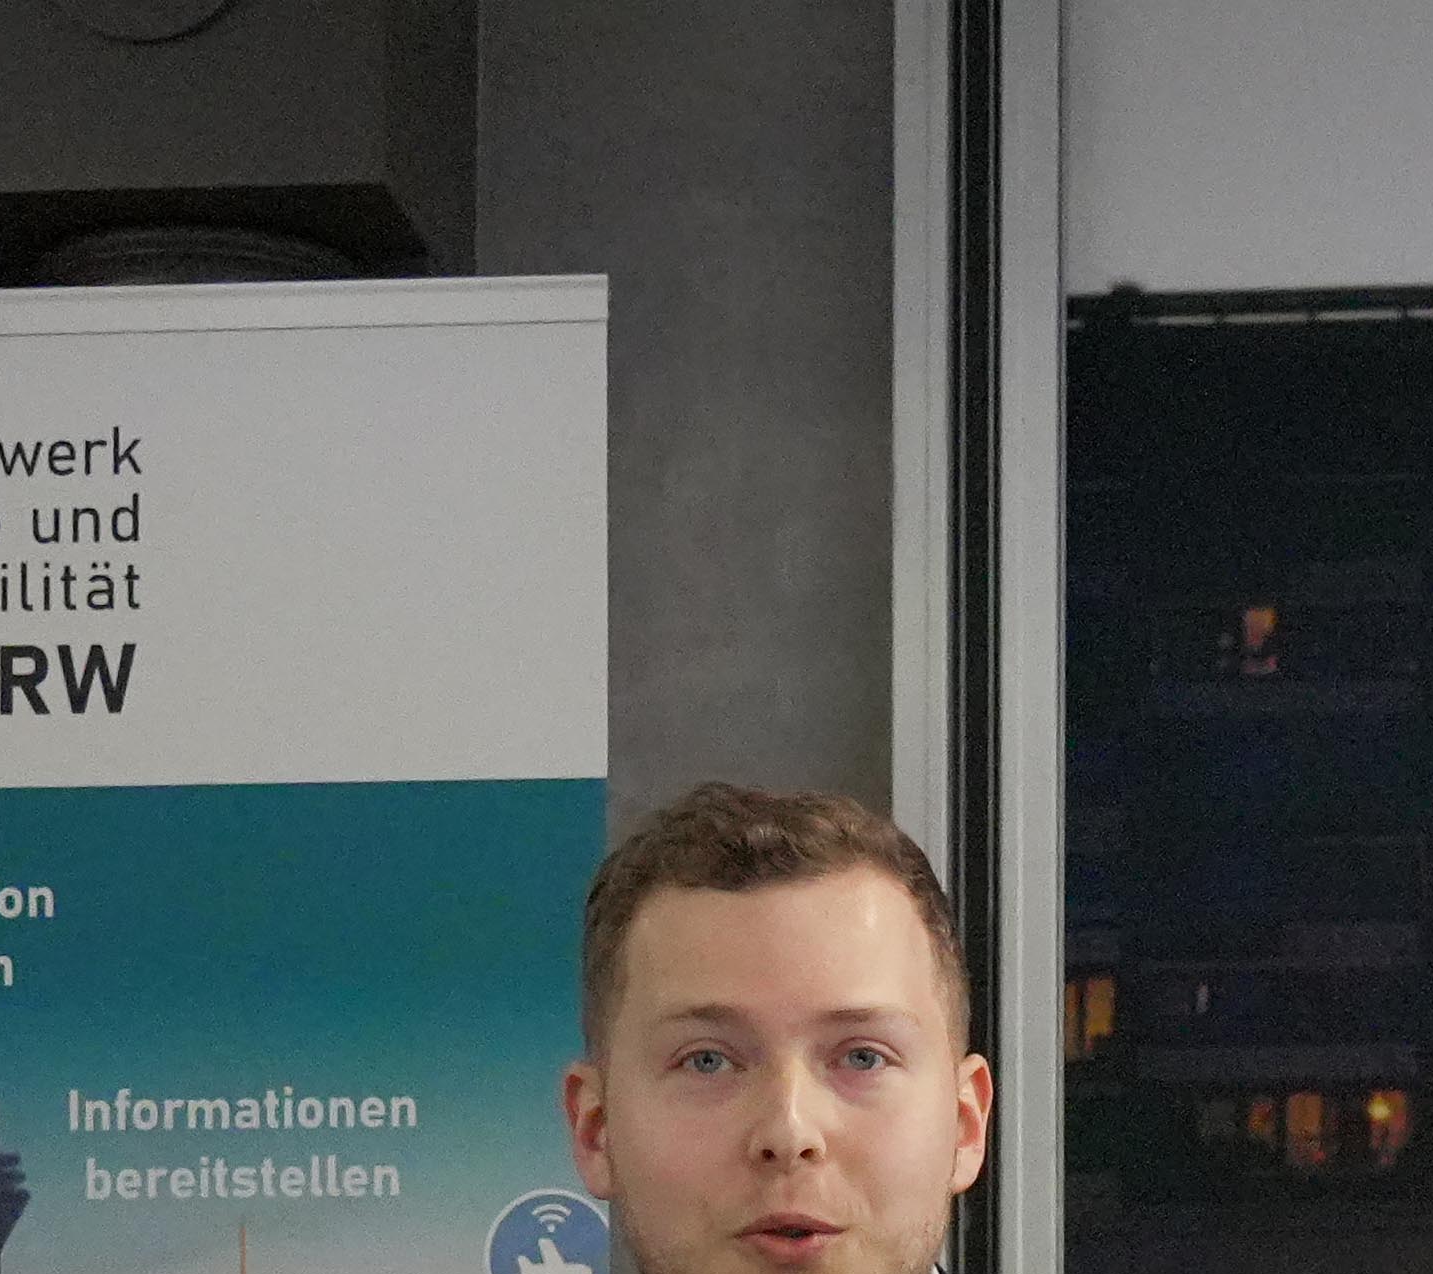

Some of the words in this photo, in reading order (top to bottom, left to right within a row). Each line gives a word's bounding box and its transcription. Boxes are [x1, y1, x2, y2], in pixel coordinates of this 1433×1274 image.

[32, 492, 140, 545] und
[68, 1086, 418, 1132] Informationen
[85, 1155, 402, 1201] bereitstellen
